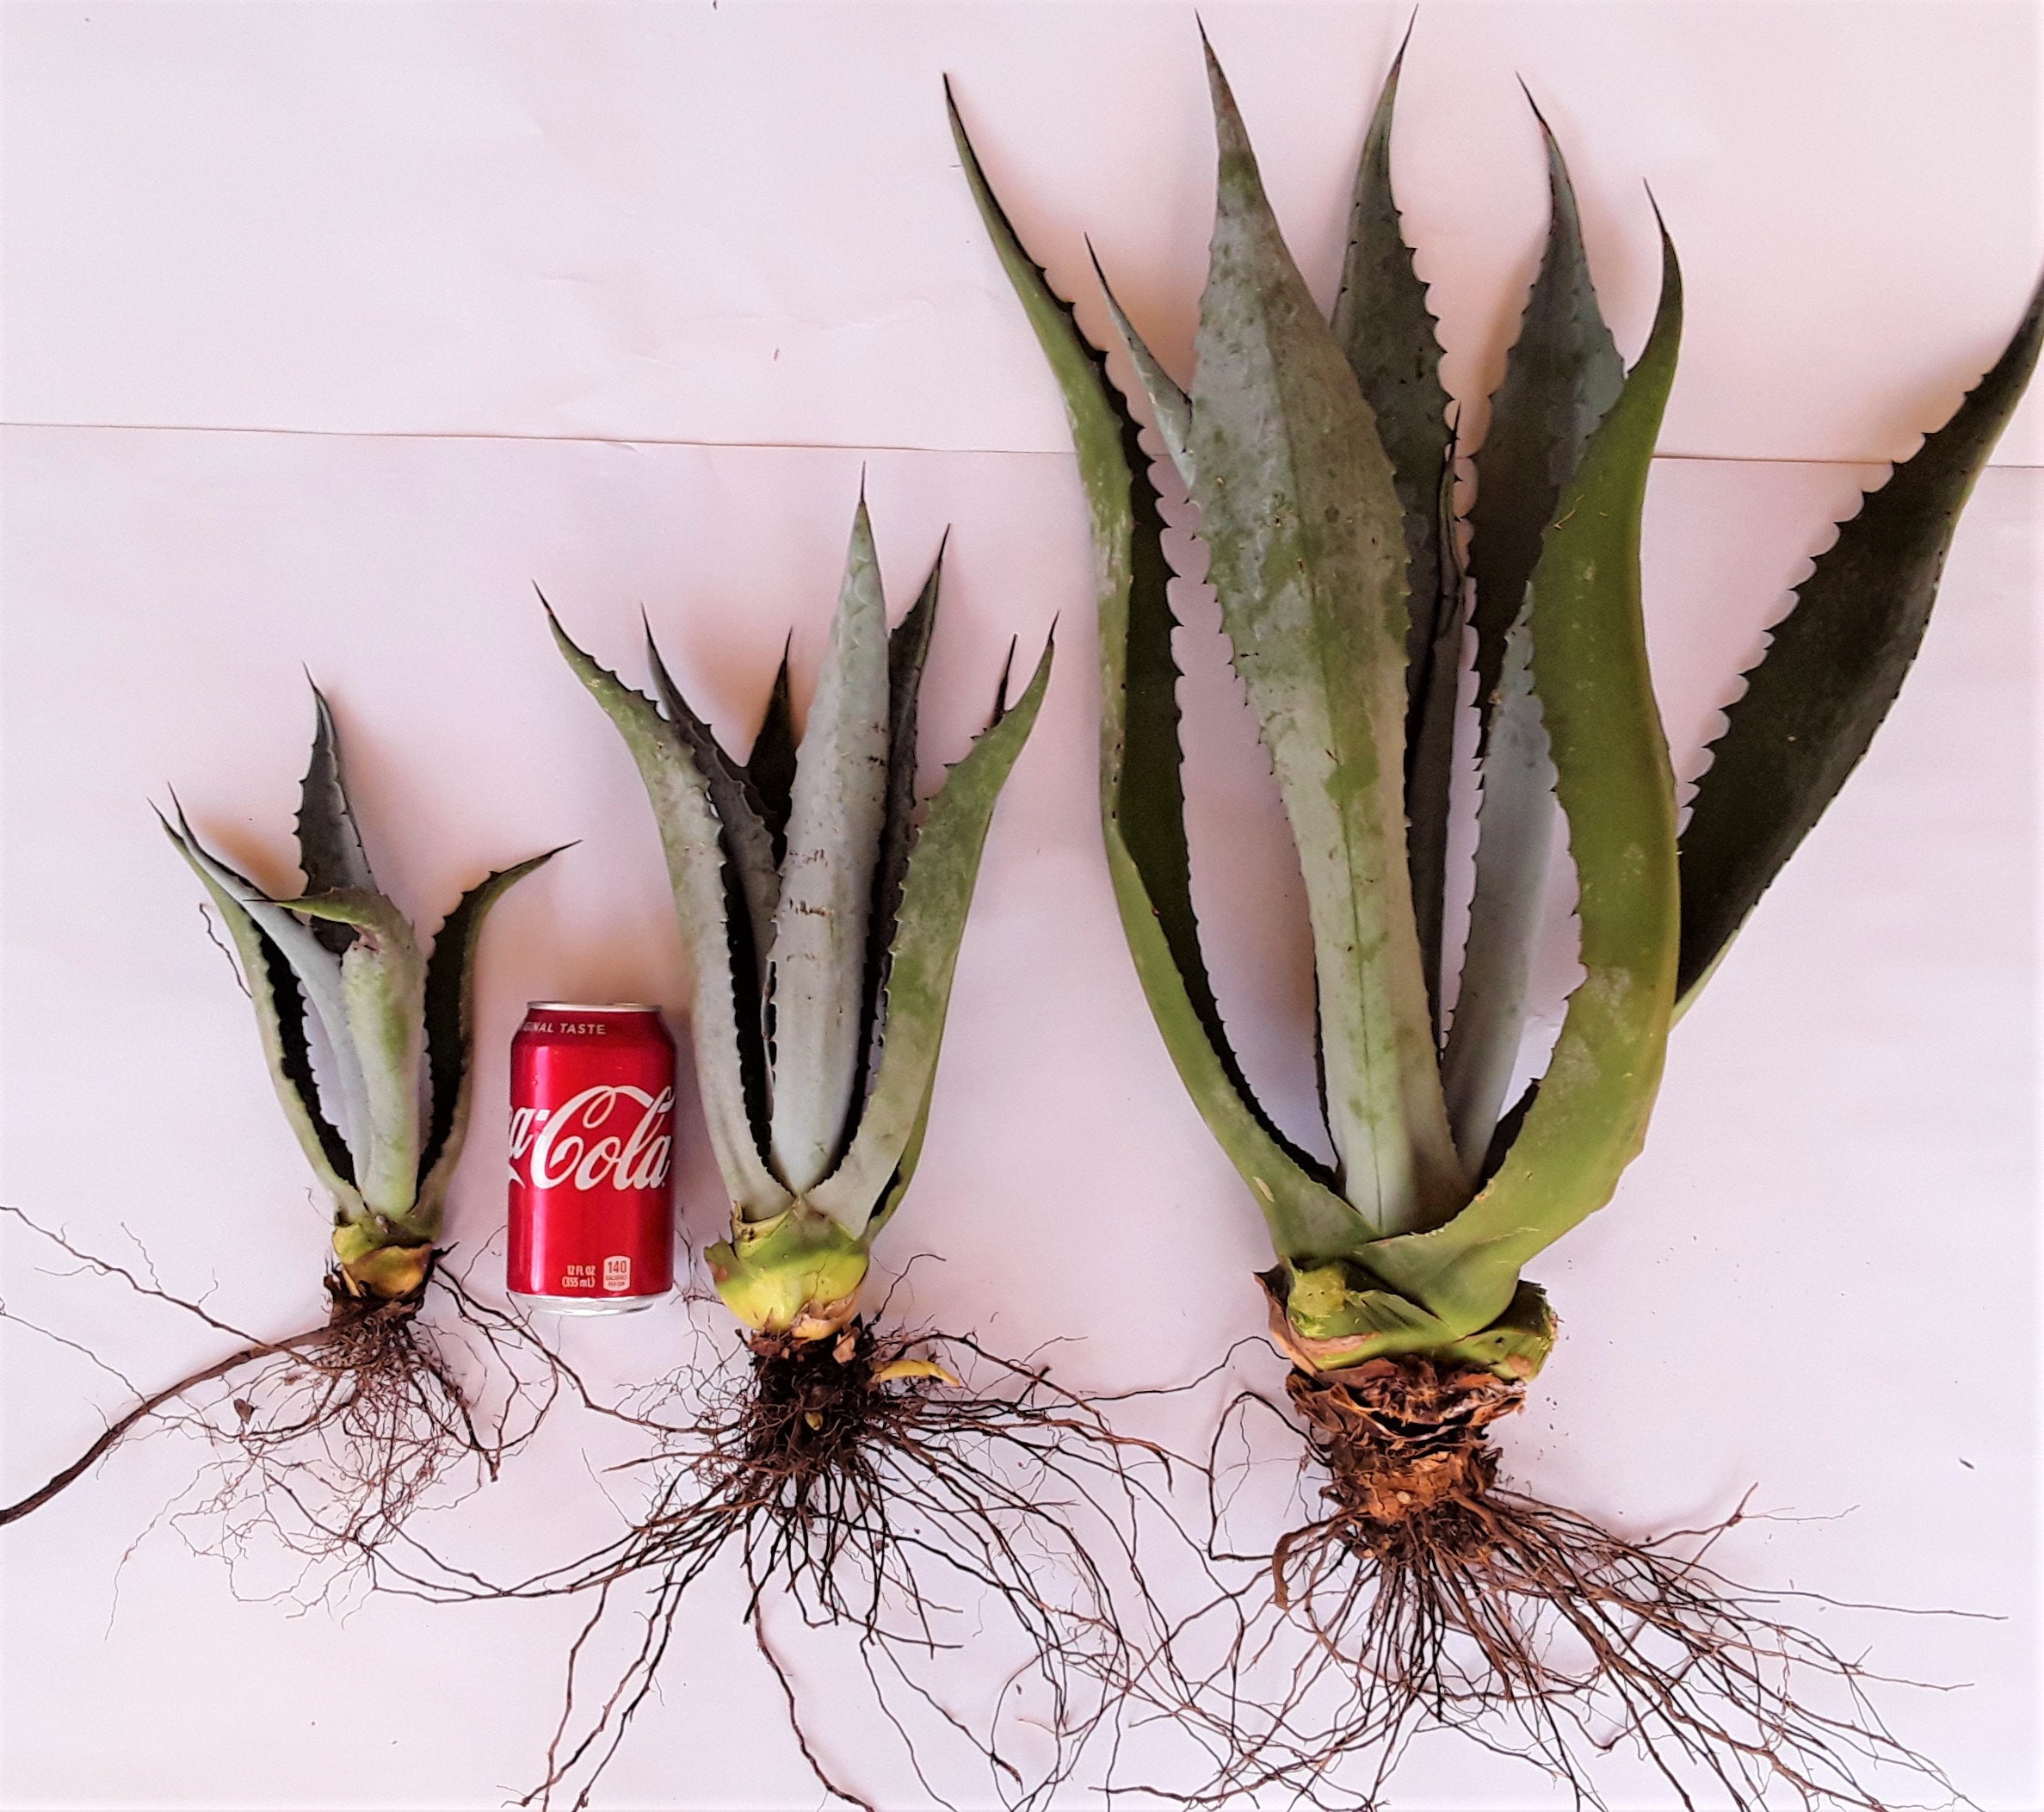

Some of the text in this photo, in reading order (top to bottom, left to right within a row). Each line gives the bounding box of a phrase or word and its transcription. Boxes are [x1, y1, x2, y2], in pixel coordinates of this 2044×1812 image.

[559, 1022, 607, 1036] TASTE
[509, 1085, 676, 1190] a-Cola
[566, 1265, 575, 1276] 12
[608, 1260, 627, 1274] 140
